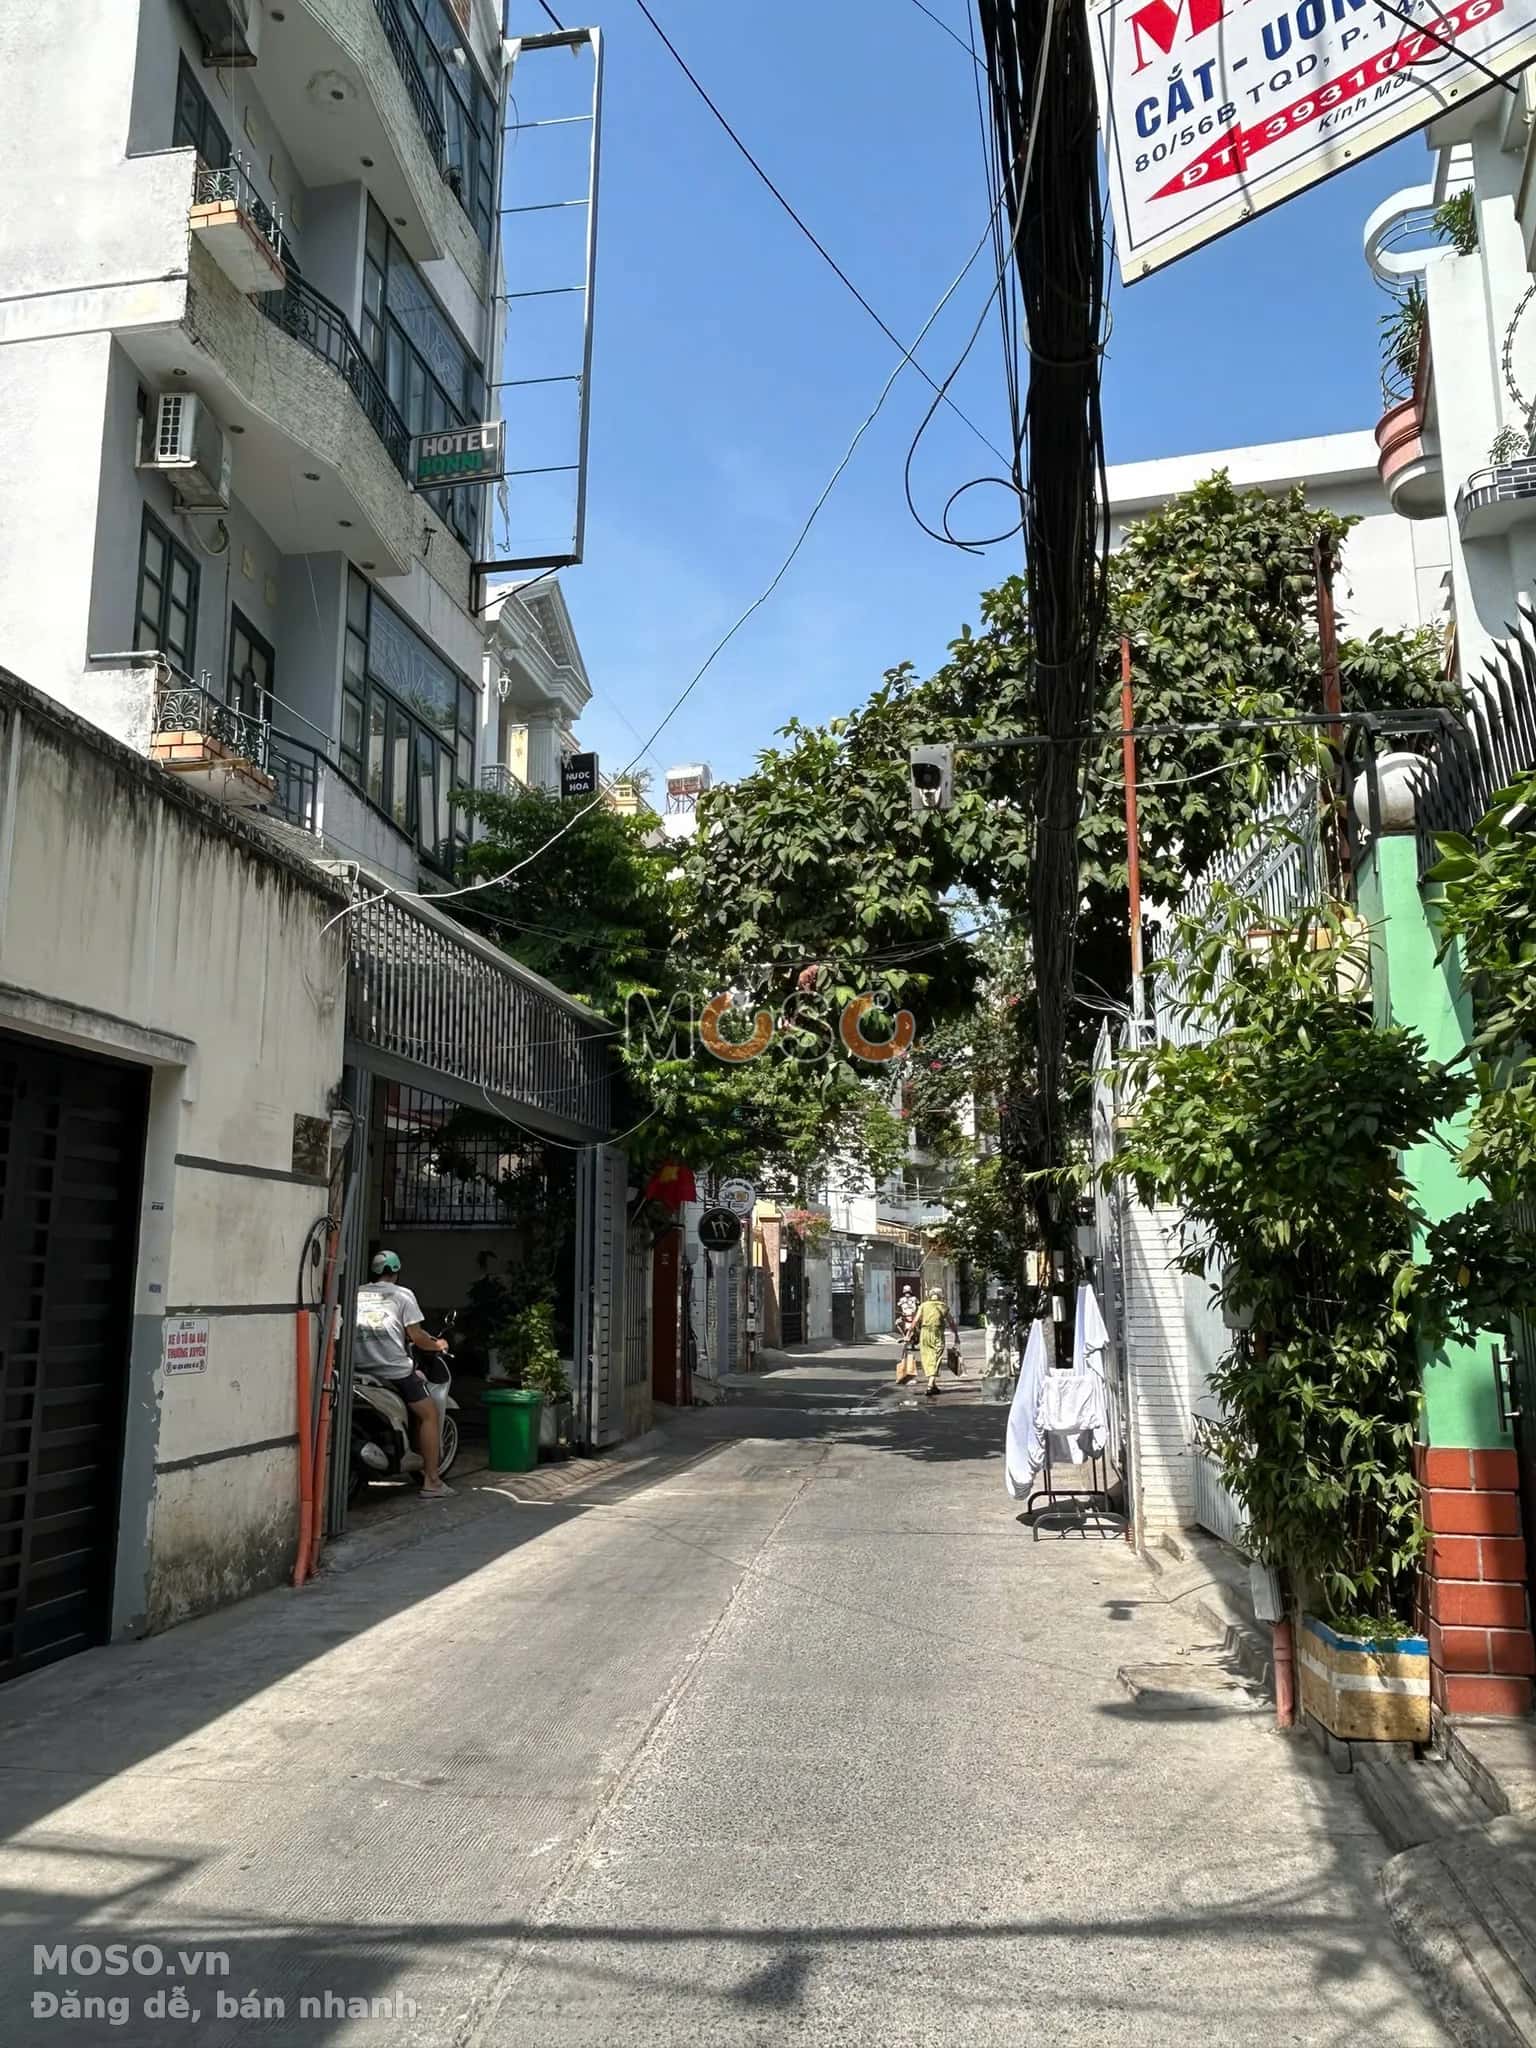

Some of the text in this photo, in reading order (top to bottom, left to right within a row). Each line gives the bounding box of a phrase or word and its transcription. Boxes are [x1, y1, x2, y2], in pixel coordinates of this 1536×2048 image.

[1135, 58, 1215, 138] CẮT
[1135, 101, 1237, 172] 80/56B
[1246, 53, 1331, 104] TQD,
[1317, 97, 1367, 133] Kính
[422, 430, 494, 457] HOTEL
